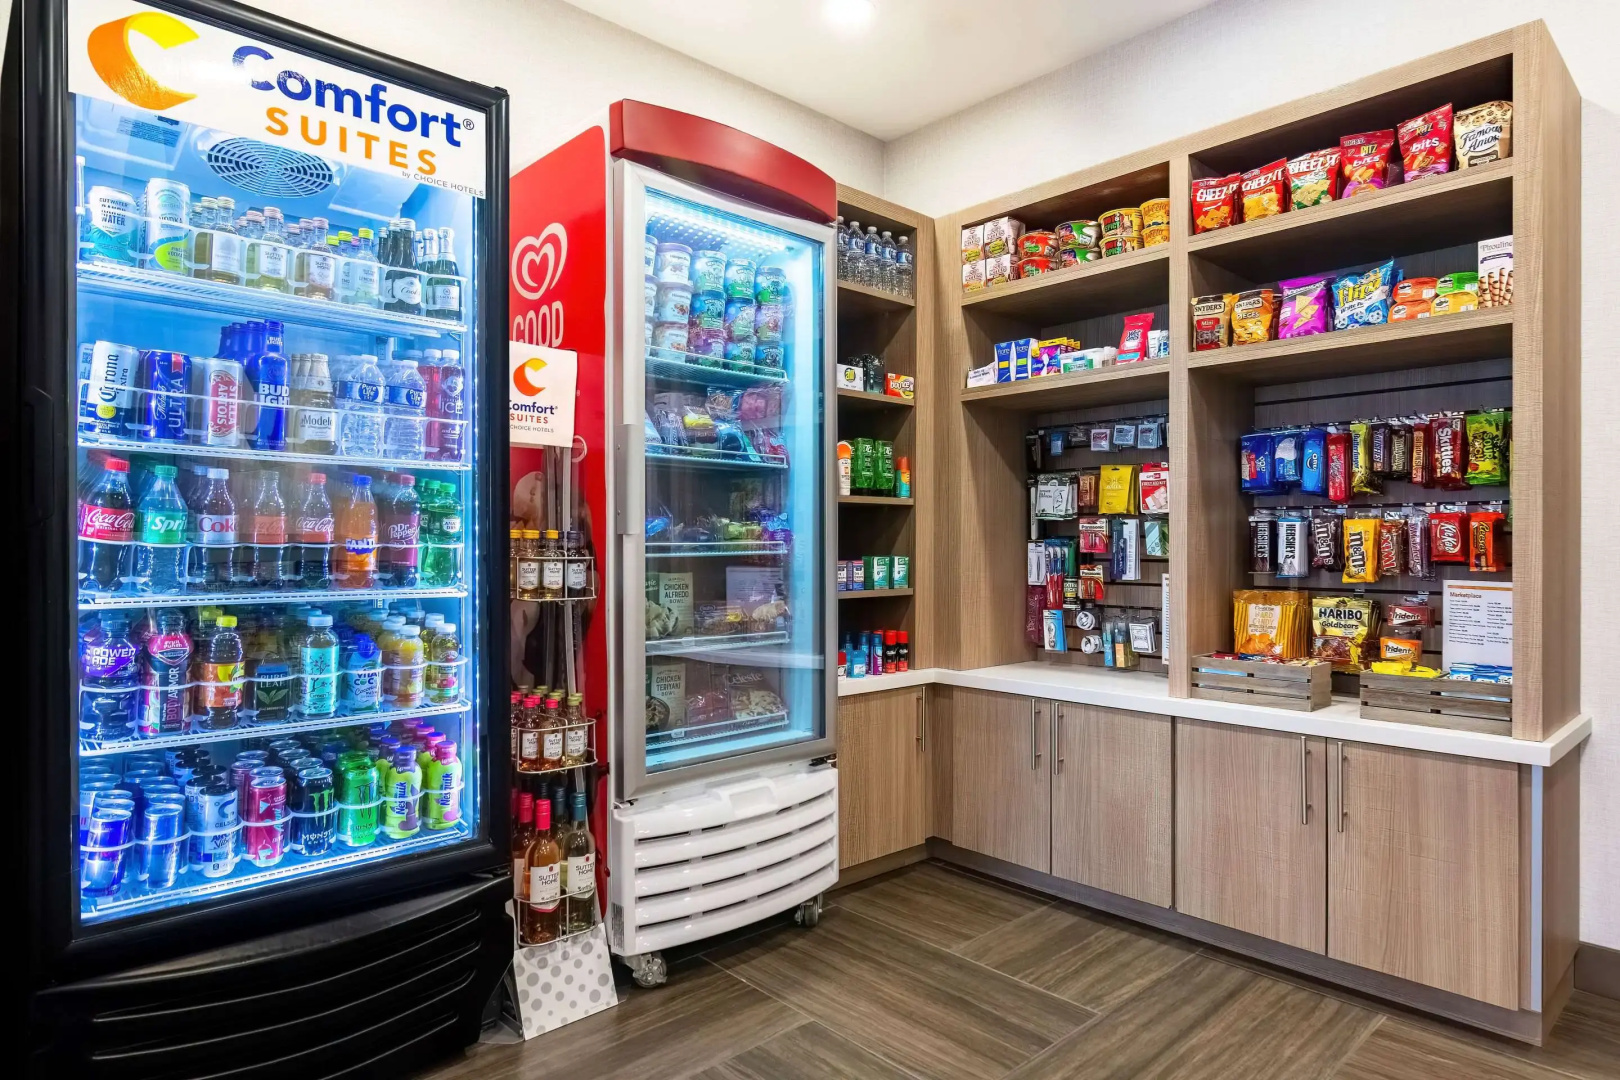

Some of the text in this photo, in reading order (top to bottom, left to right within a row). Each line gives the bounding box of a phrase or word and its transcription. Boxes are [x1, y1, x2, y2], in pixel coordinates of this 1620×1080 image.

[1415, 122, 1434, 136] RITZ
[265, 107, 437, 176] SUITES
[1459, 125, 1502, 149] Famous
[1360, 144, 1378, 156] RITZ
[1411, 137, 1440, 153] bits
[1353, 154, 1380, 167] bits
[401, 169, 485, 197] by CHOICE HOTELS
[258, 383, 290, 397] BUD
[441, 401, 463, 415] ICE
[1438, 427, 1453, 474] Skittles
[151, 516, 187, 533] Sprit
[397, 523, 410, 532] Dr
[389, 525, 416, 539] Pepper
[1478, 521, 1490, 554] Reese's
[346, 538, 375, 550] FANT
[1257, 522, 1268, 558] HERSHEY'S
[1285, 523, 1296, 560] HERSHEY'S
[663, 583, 689, 591] CHICKEN
[664, 590, 689, 599] ALFREDO
[1449, 591, 1482, 599] Marketplace
[1318, 607, 1362, 620] HARIBO
[1391, 611, 1420, 621] Trident
[1321, 620, 1359, 630] Goldbears
[1384, 644, 1411, 654] Trident
[656, 675, 682, 684] CHICKEN
[656, 683, 681, 691] TERIYAKI
[302, 828, 334, 840] MONST
